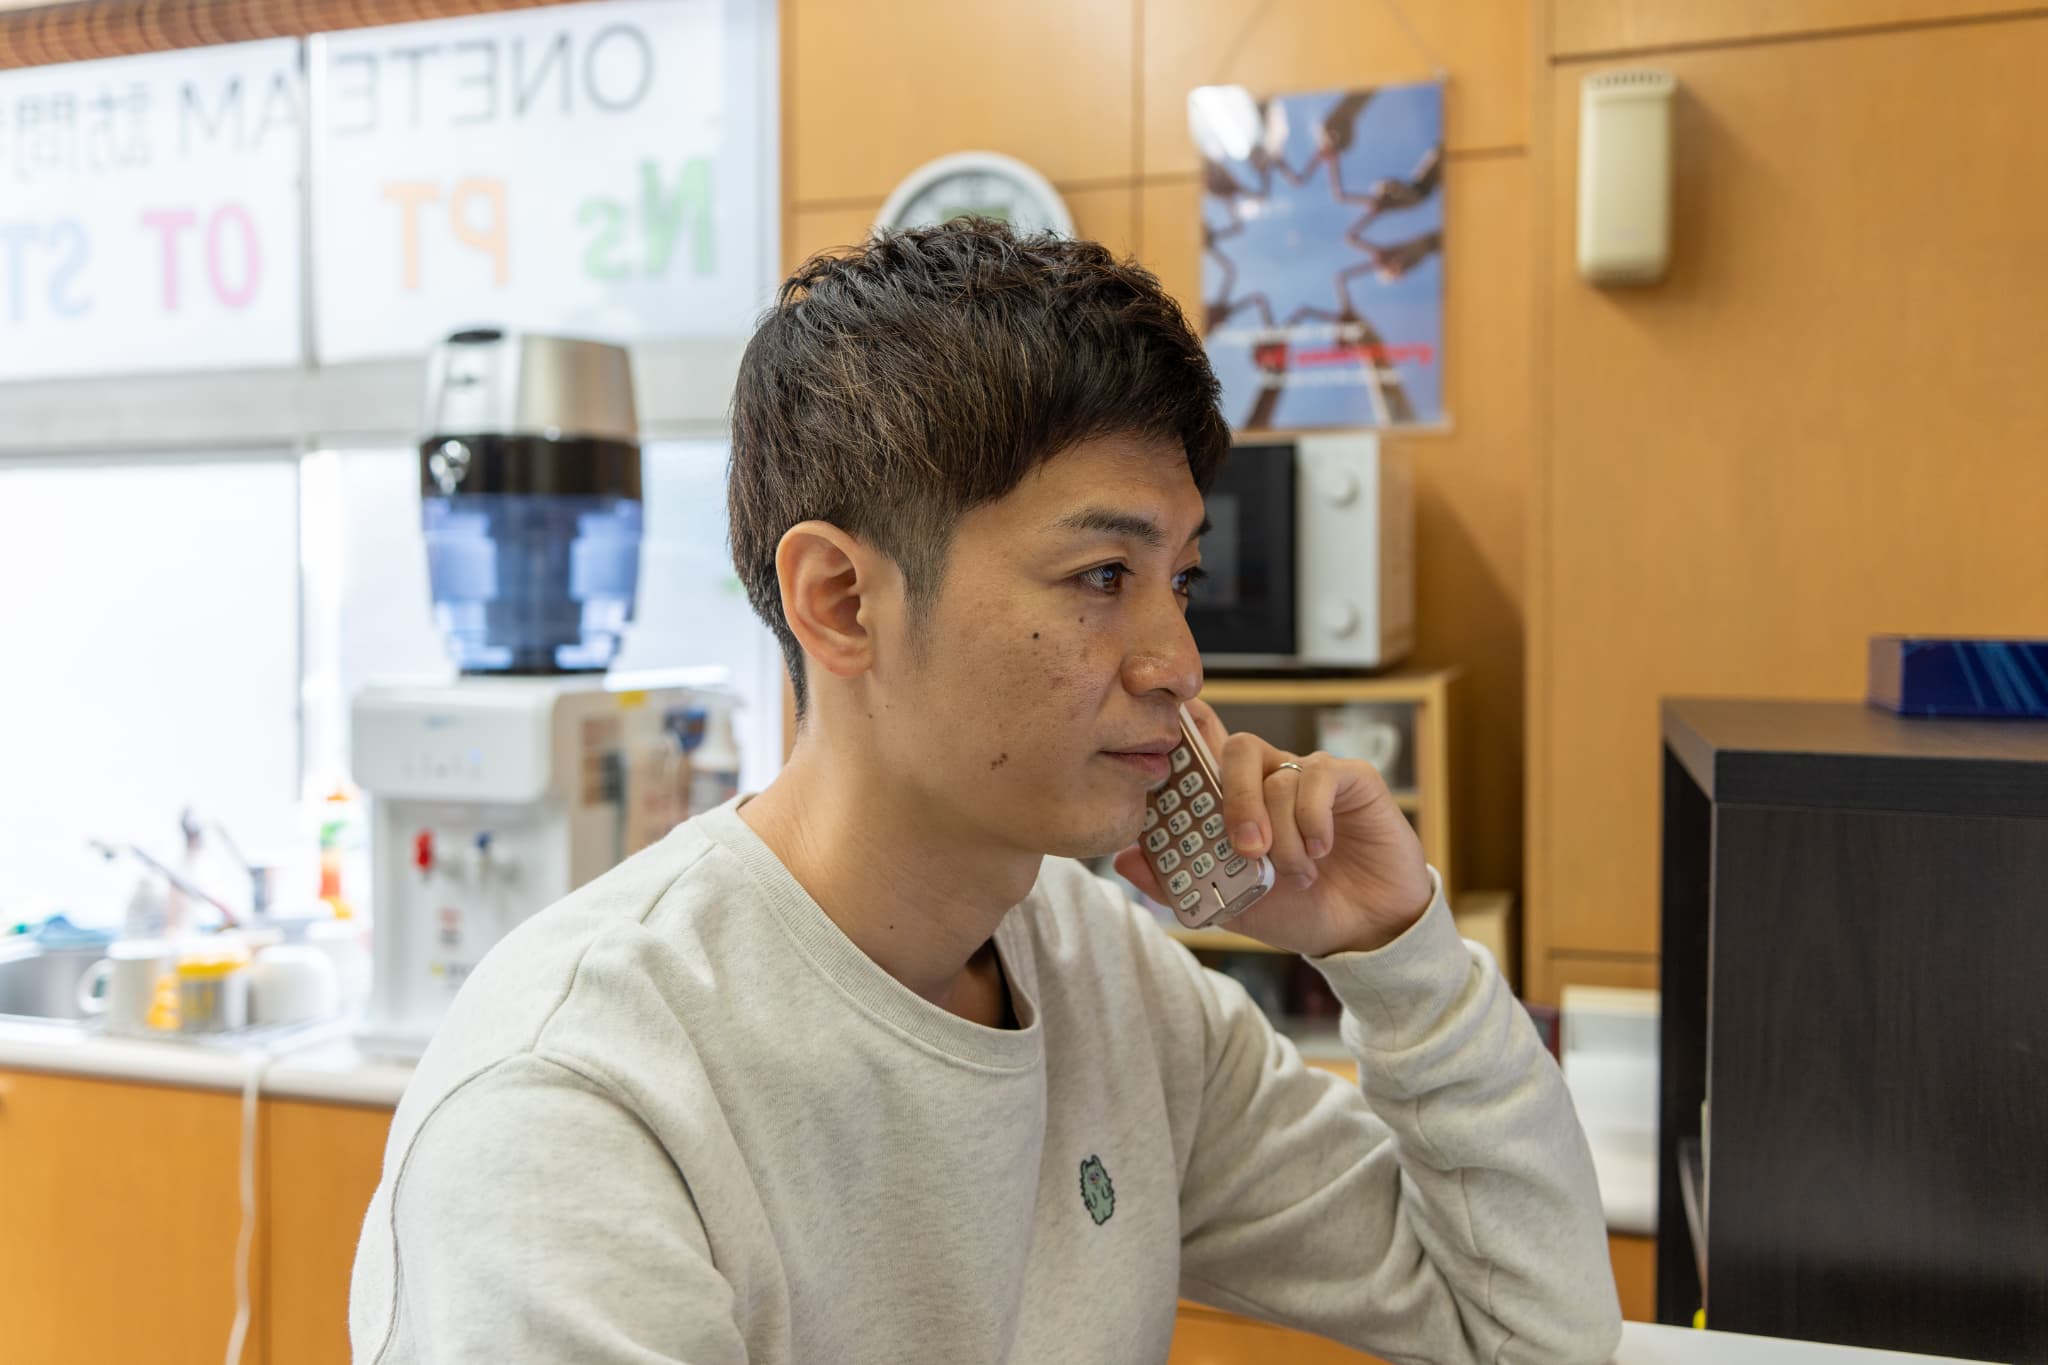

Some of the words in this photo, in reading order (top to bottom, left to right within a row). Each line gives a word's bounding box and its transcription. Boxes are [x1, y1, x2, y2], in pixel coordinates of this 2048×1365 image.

[1159, 798, 1169, 812] 2
[1182, 780, 1192, 793] 3
[1150, 835, 1158, 848] 4
[1170, 818, 1180, 832] 5
[1193, 800, 1203, 814] 6
[1160, 857, 1168, 870] 7
[1182, 840, 1192, 853] 8
[1204, 822, 1214, 836] 9
[1193, 861, 1203, 874] 0
